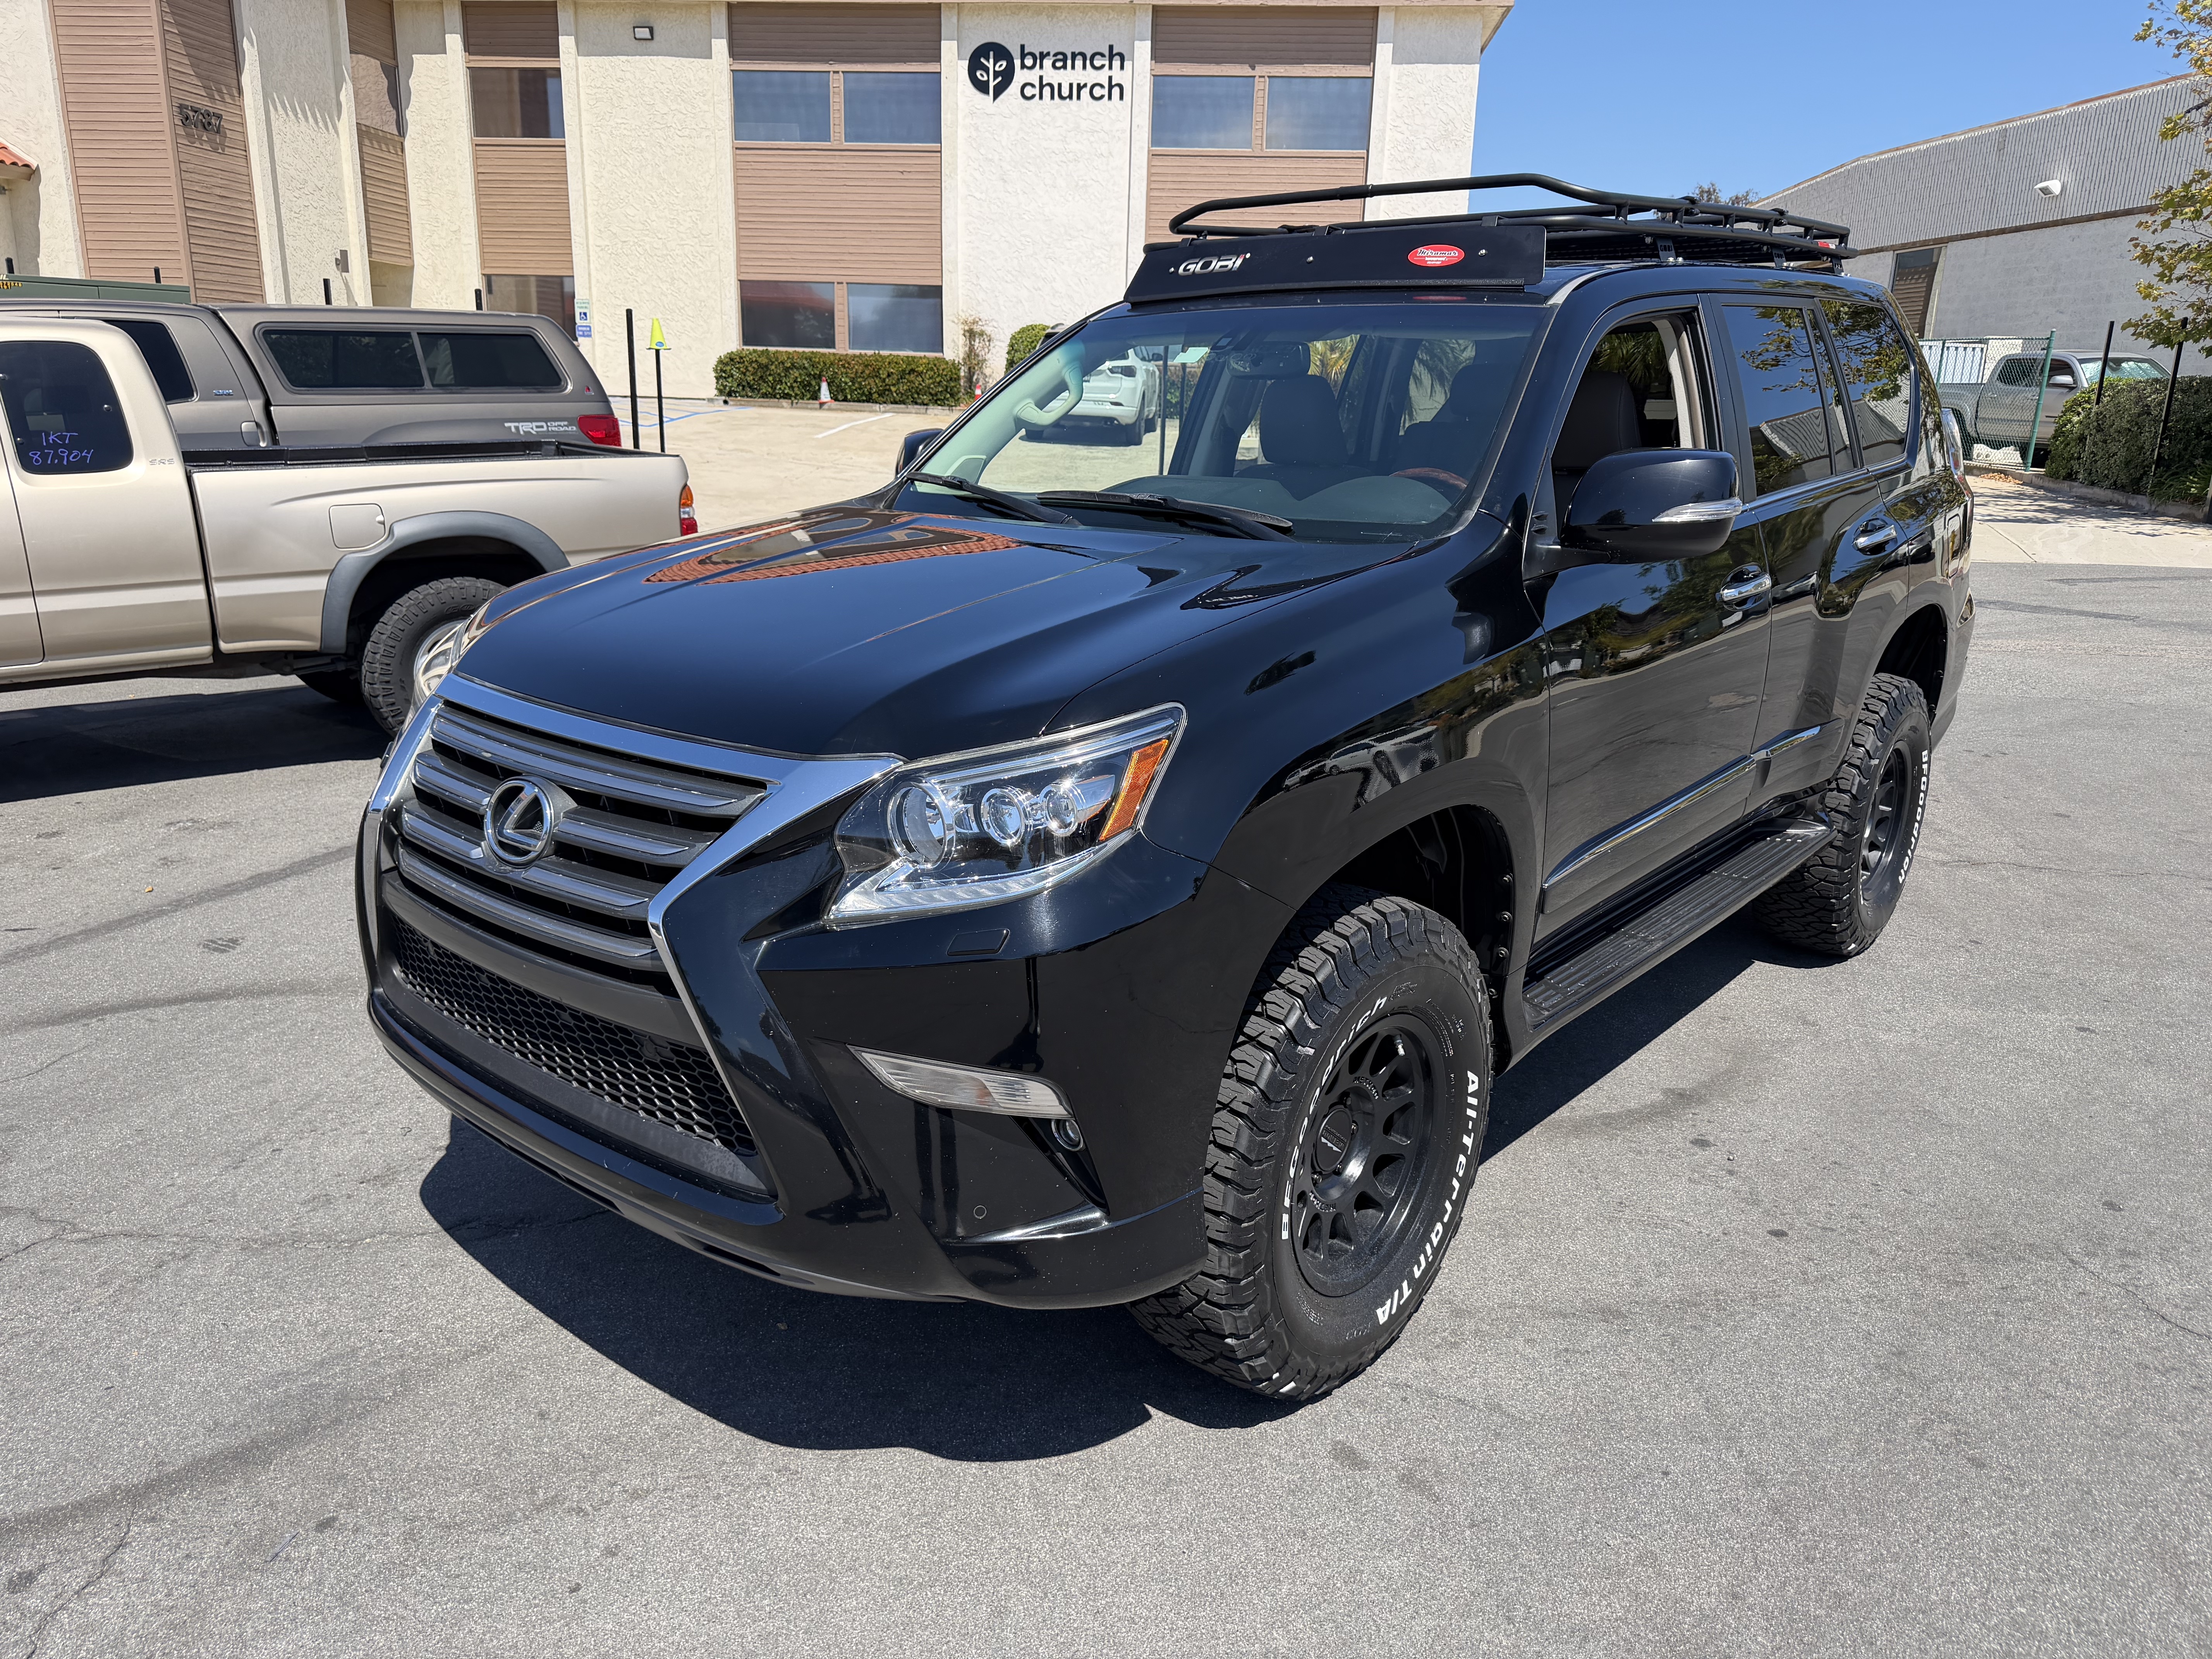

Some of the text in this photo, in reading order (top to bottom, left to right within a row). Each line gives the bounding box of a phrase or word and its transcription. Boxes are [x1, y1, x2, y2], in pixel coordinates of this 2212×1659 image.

[1020, 44, 1125, 71] branch
[1020, 75, 1124, 101] church
[179, 103, 223, 134] 5787
[1178, 254, 1245, 276] GOBI
[1417, 248, 1458, 256] Miramar
[504, 421, 547, 434] TRD
[1281, 996, 1387, 1240] BFGoodrich
[1413, 1070, 1479, 1278] All-Terrain
[1376, 1279, 1412, 1325] T/A
